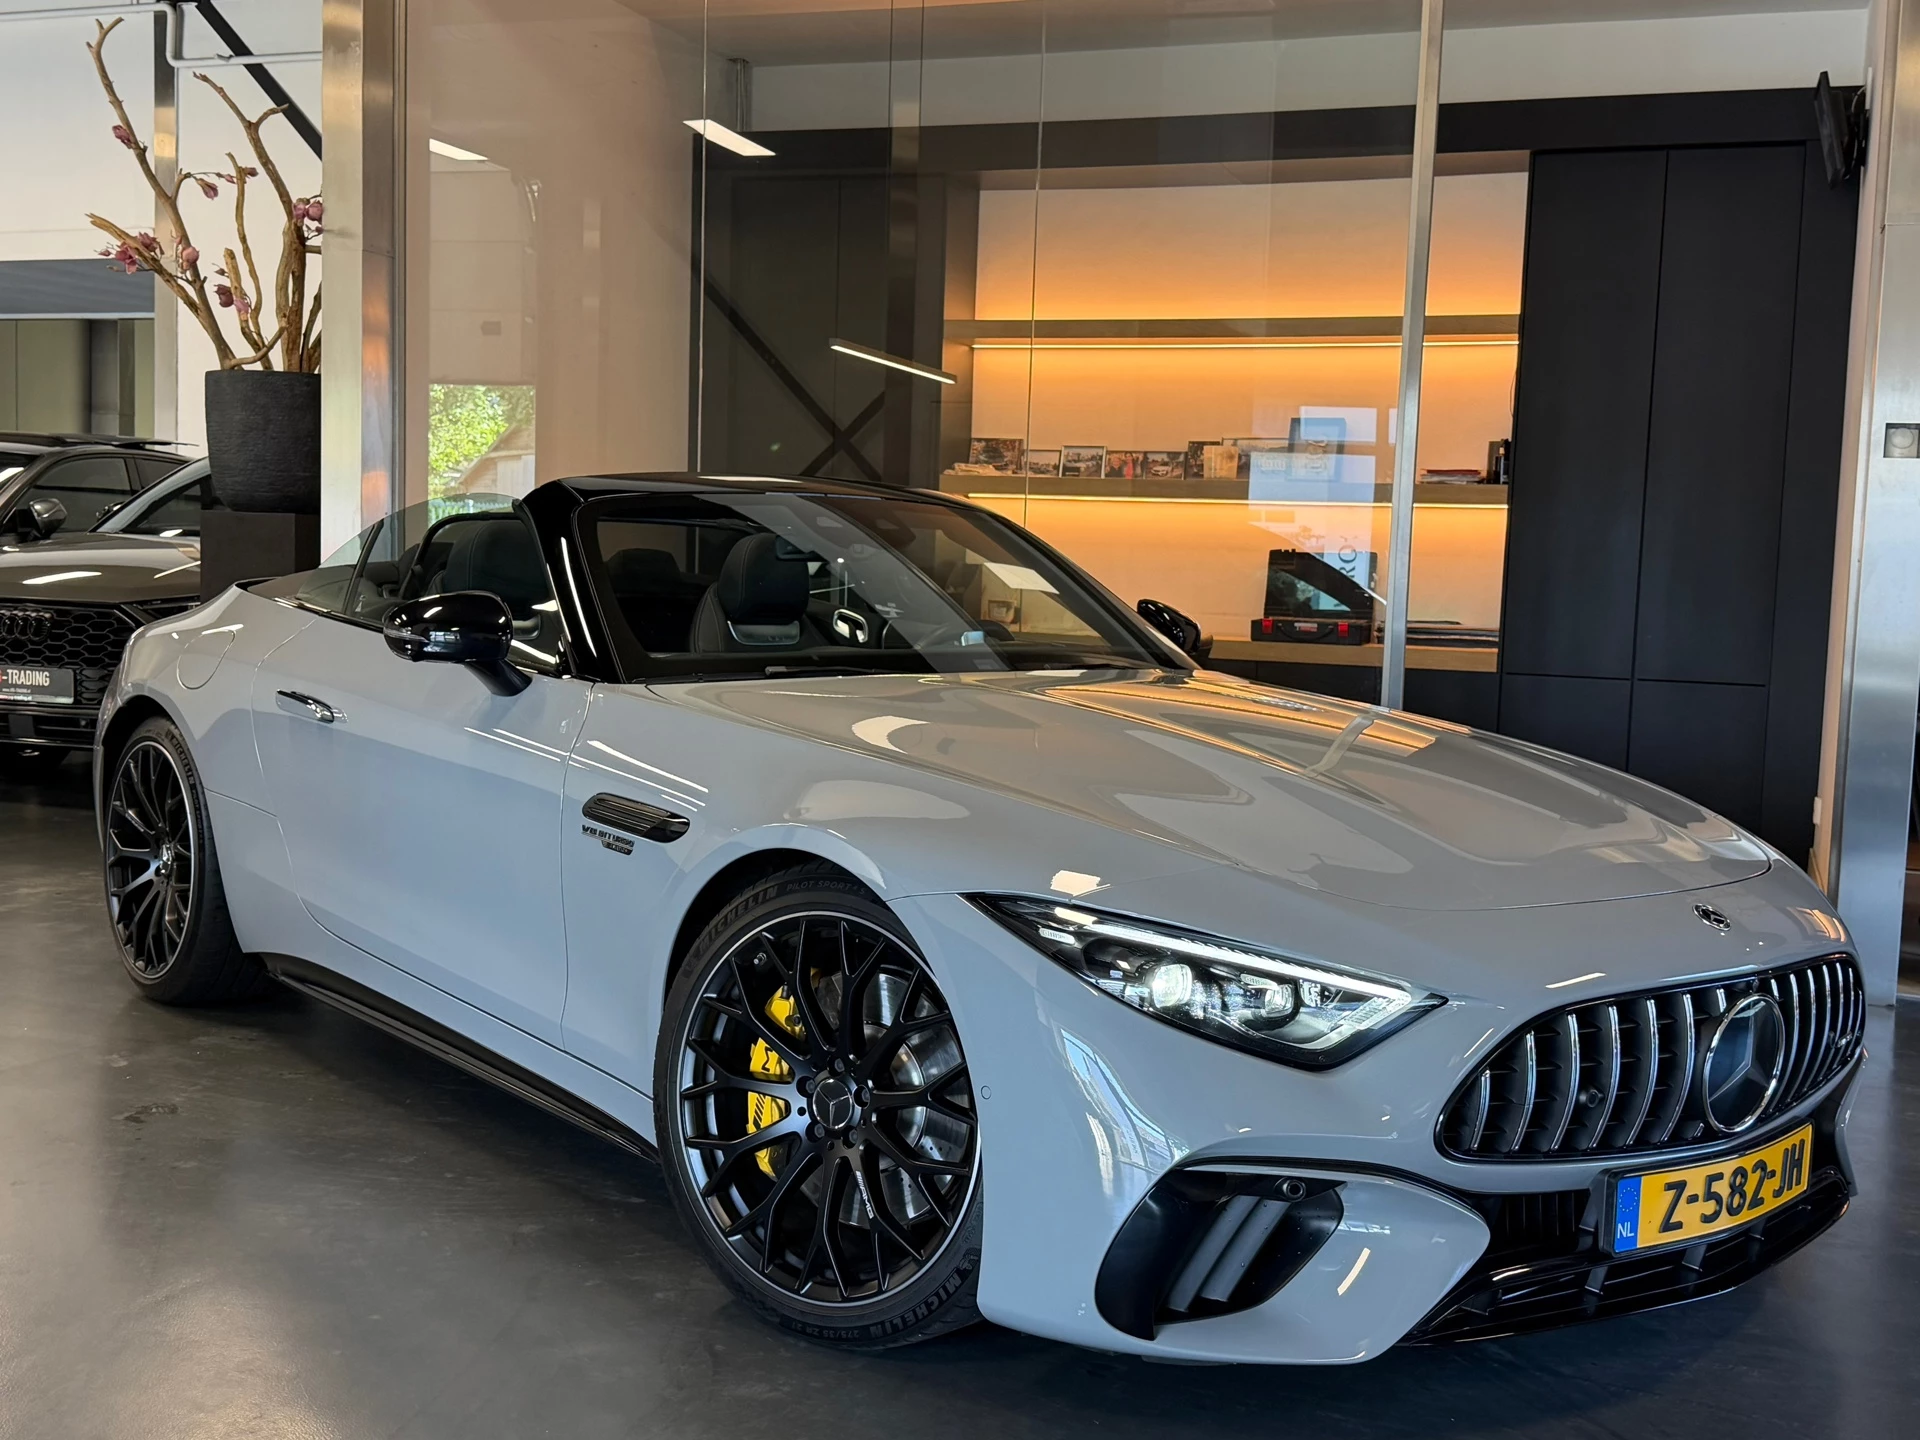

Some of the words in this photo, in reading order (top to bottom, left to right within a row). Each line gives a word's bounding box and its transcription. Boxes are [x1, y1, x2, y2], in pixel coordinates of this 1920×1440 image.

[0, 669, 50, 687] -TRADING
[698, 885, 779, 956] MICHELIN
[786, 881, 813, 892] PILOT
[817, 879, 850, 891] SPORT
[1658, 1138, 1806, 1234] Z-582-JH
[1617, 1222, 1635, 1239] NL
[869, 1271, 962, 1338] MICHELIN
[823, 1328, 860, 1339] 275/35
